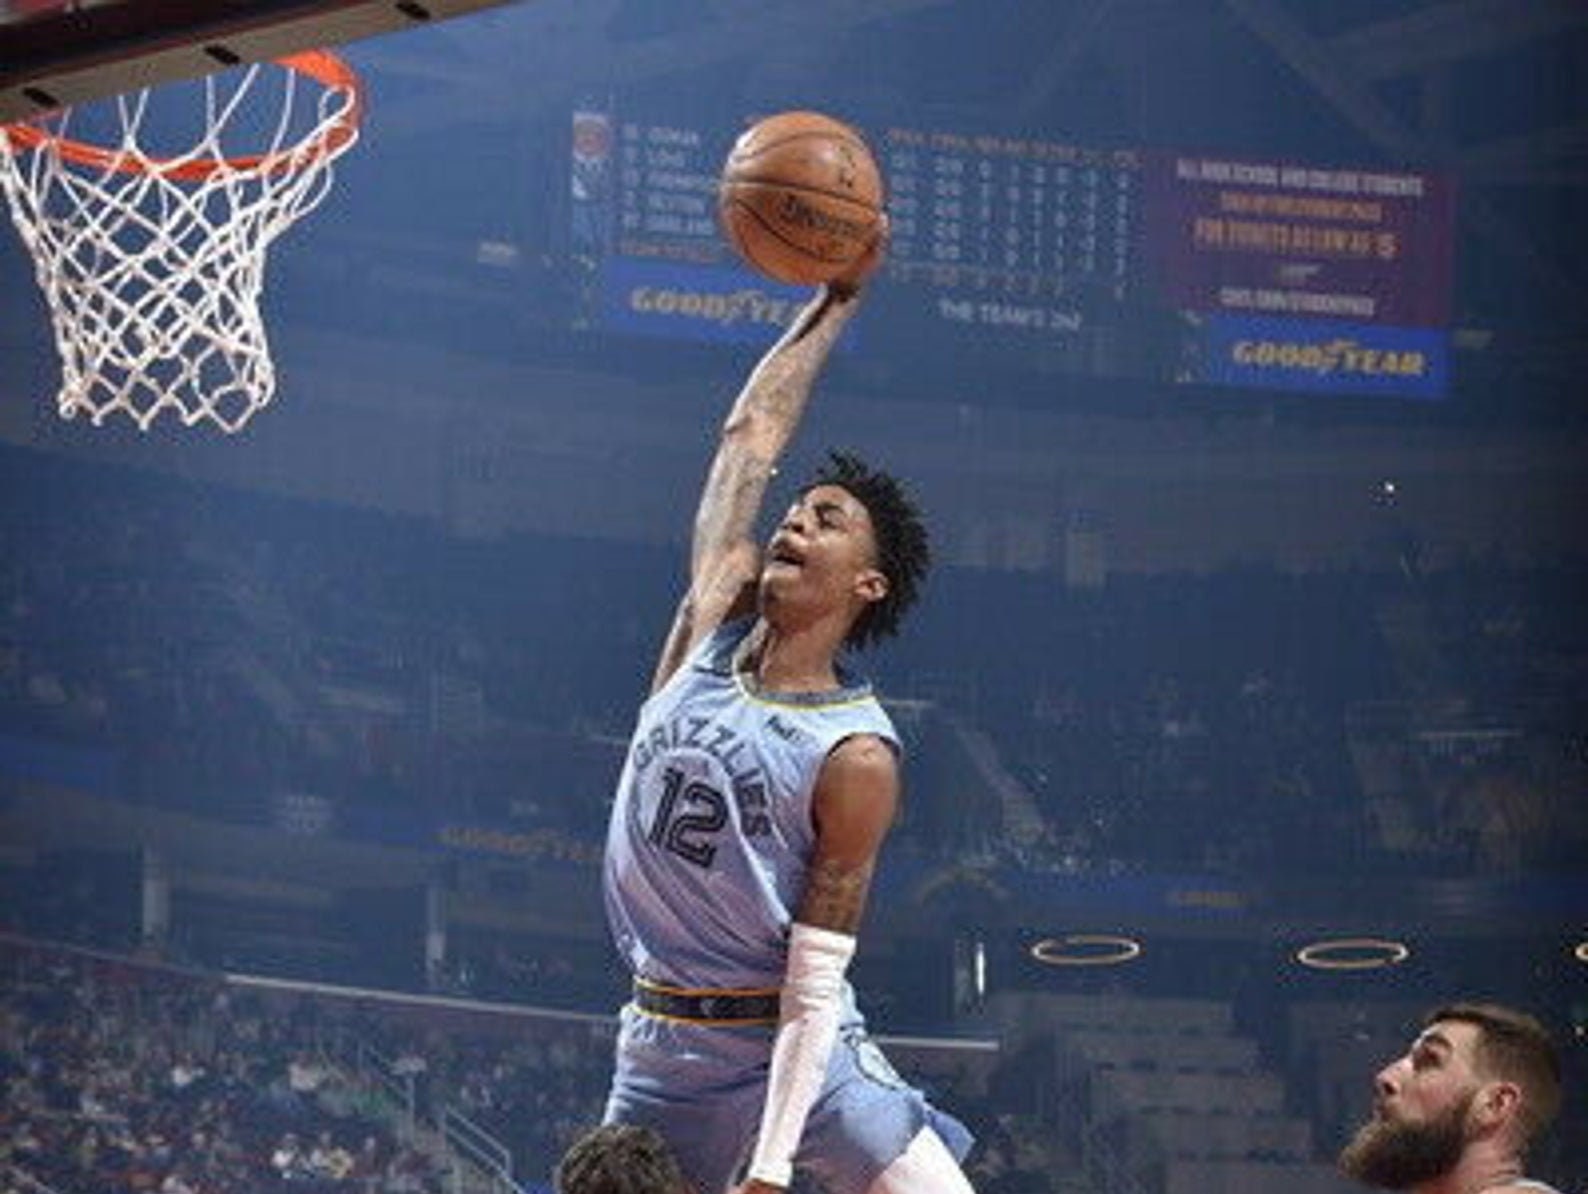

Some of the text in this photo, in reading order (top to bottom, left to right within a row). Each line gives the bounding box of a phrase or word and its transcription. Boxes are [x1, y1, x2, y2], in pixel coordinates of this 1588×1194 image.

[1233, 338, 1424, 376] GOODYEAR
[634, 715, 772, 838] GRIZZLIES
[647, 766, 729, 868] 12
